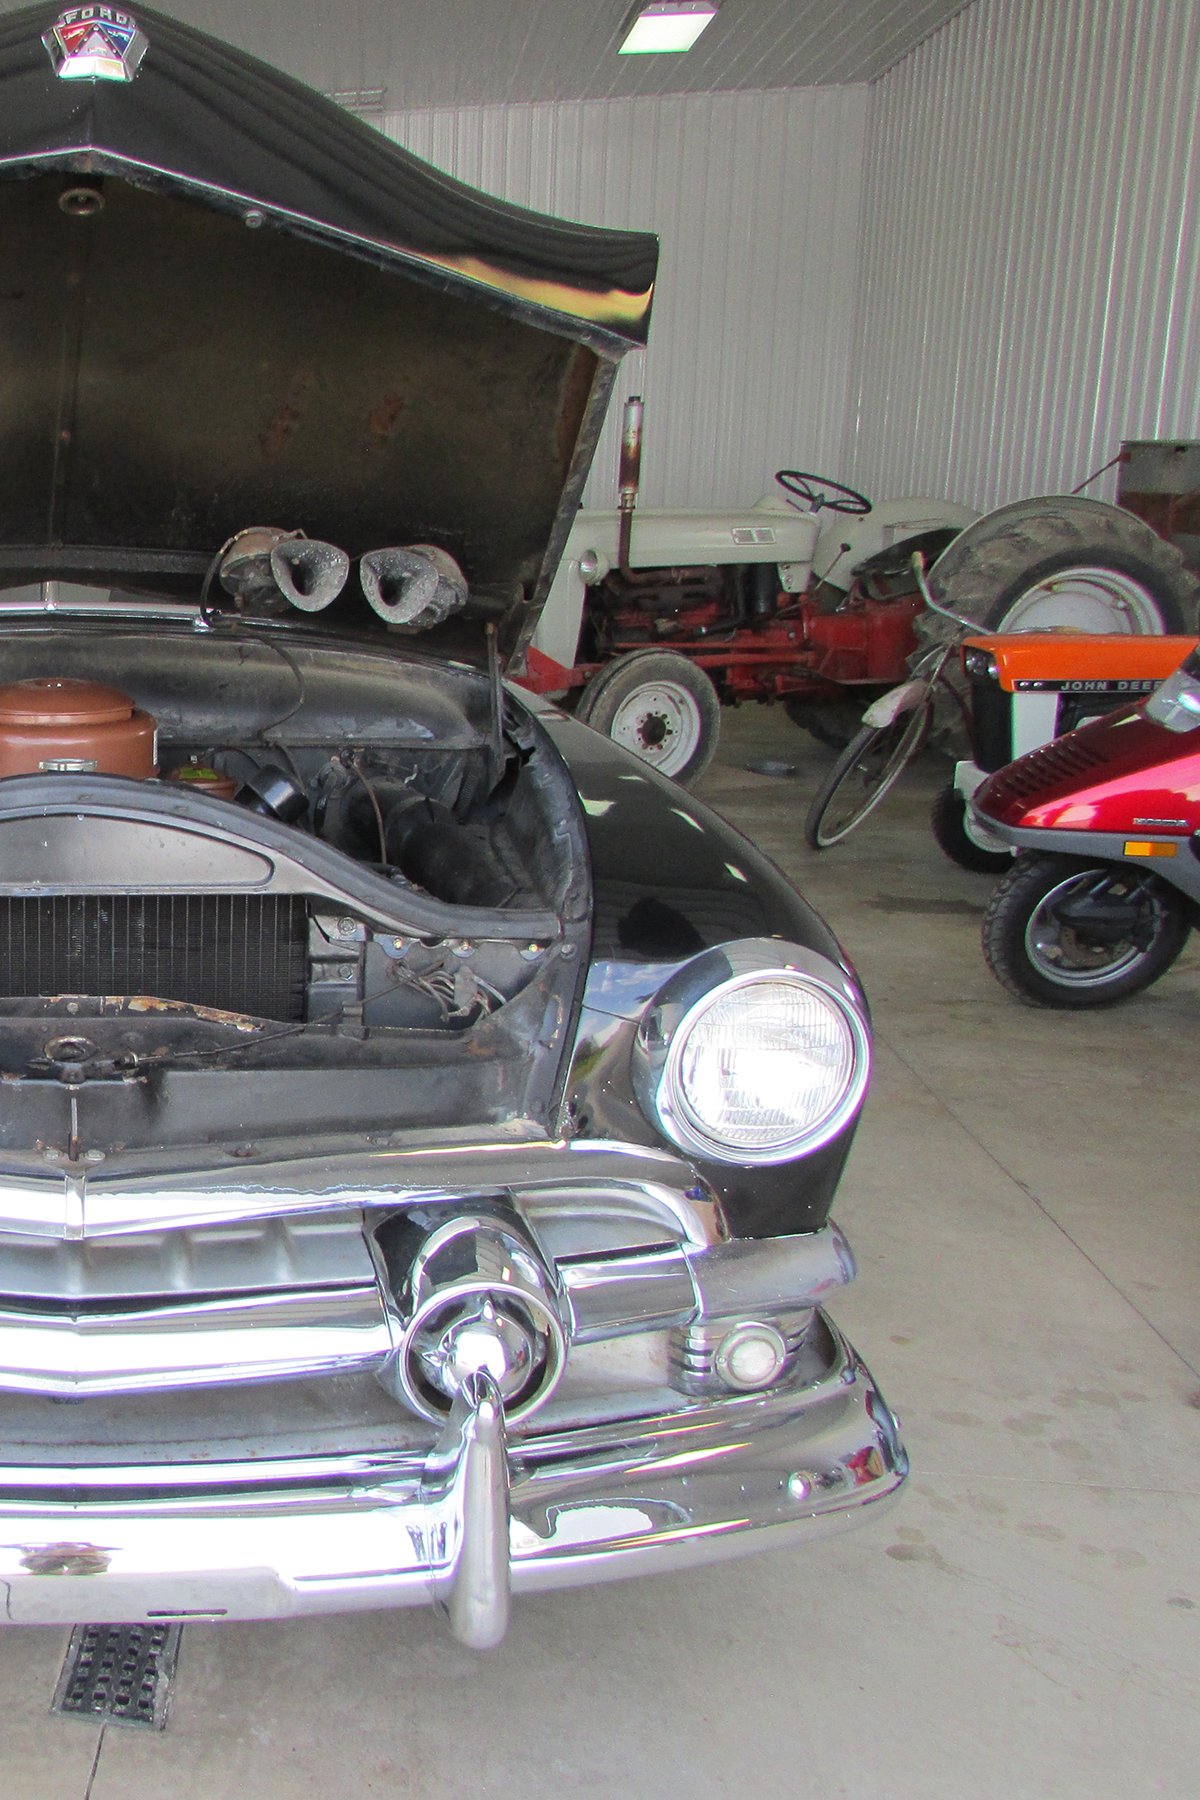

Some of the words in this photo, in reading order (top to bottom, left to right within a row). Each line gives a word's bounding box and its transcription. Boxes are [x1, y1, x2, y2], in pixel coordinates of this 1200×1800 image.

[66, 7, 128, 25] FORD
[1060, 681, 1107, 690] JOHN
[1117, 681, 1162, 690] DEE
